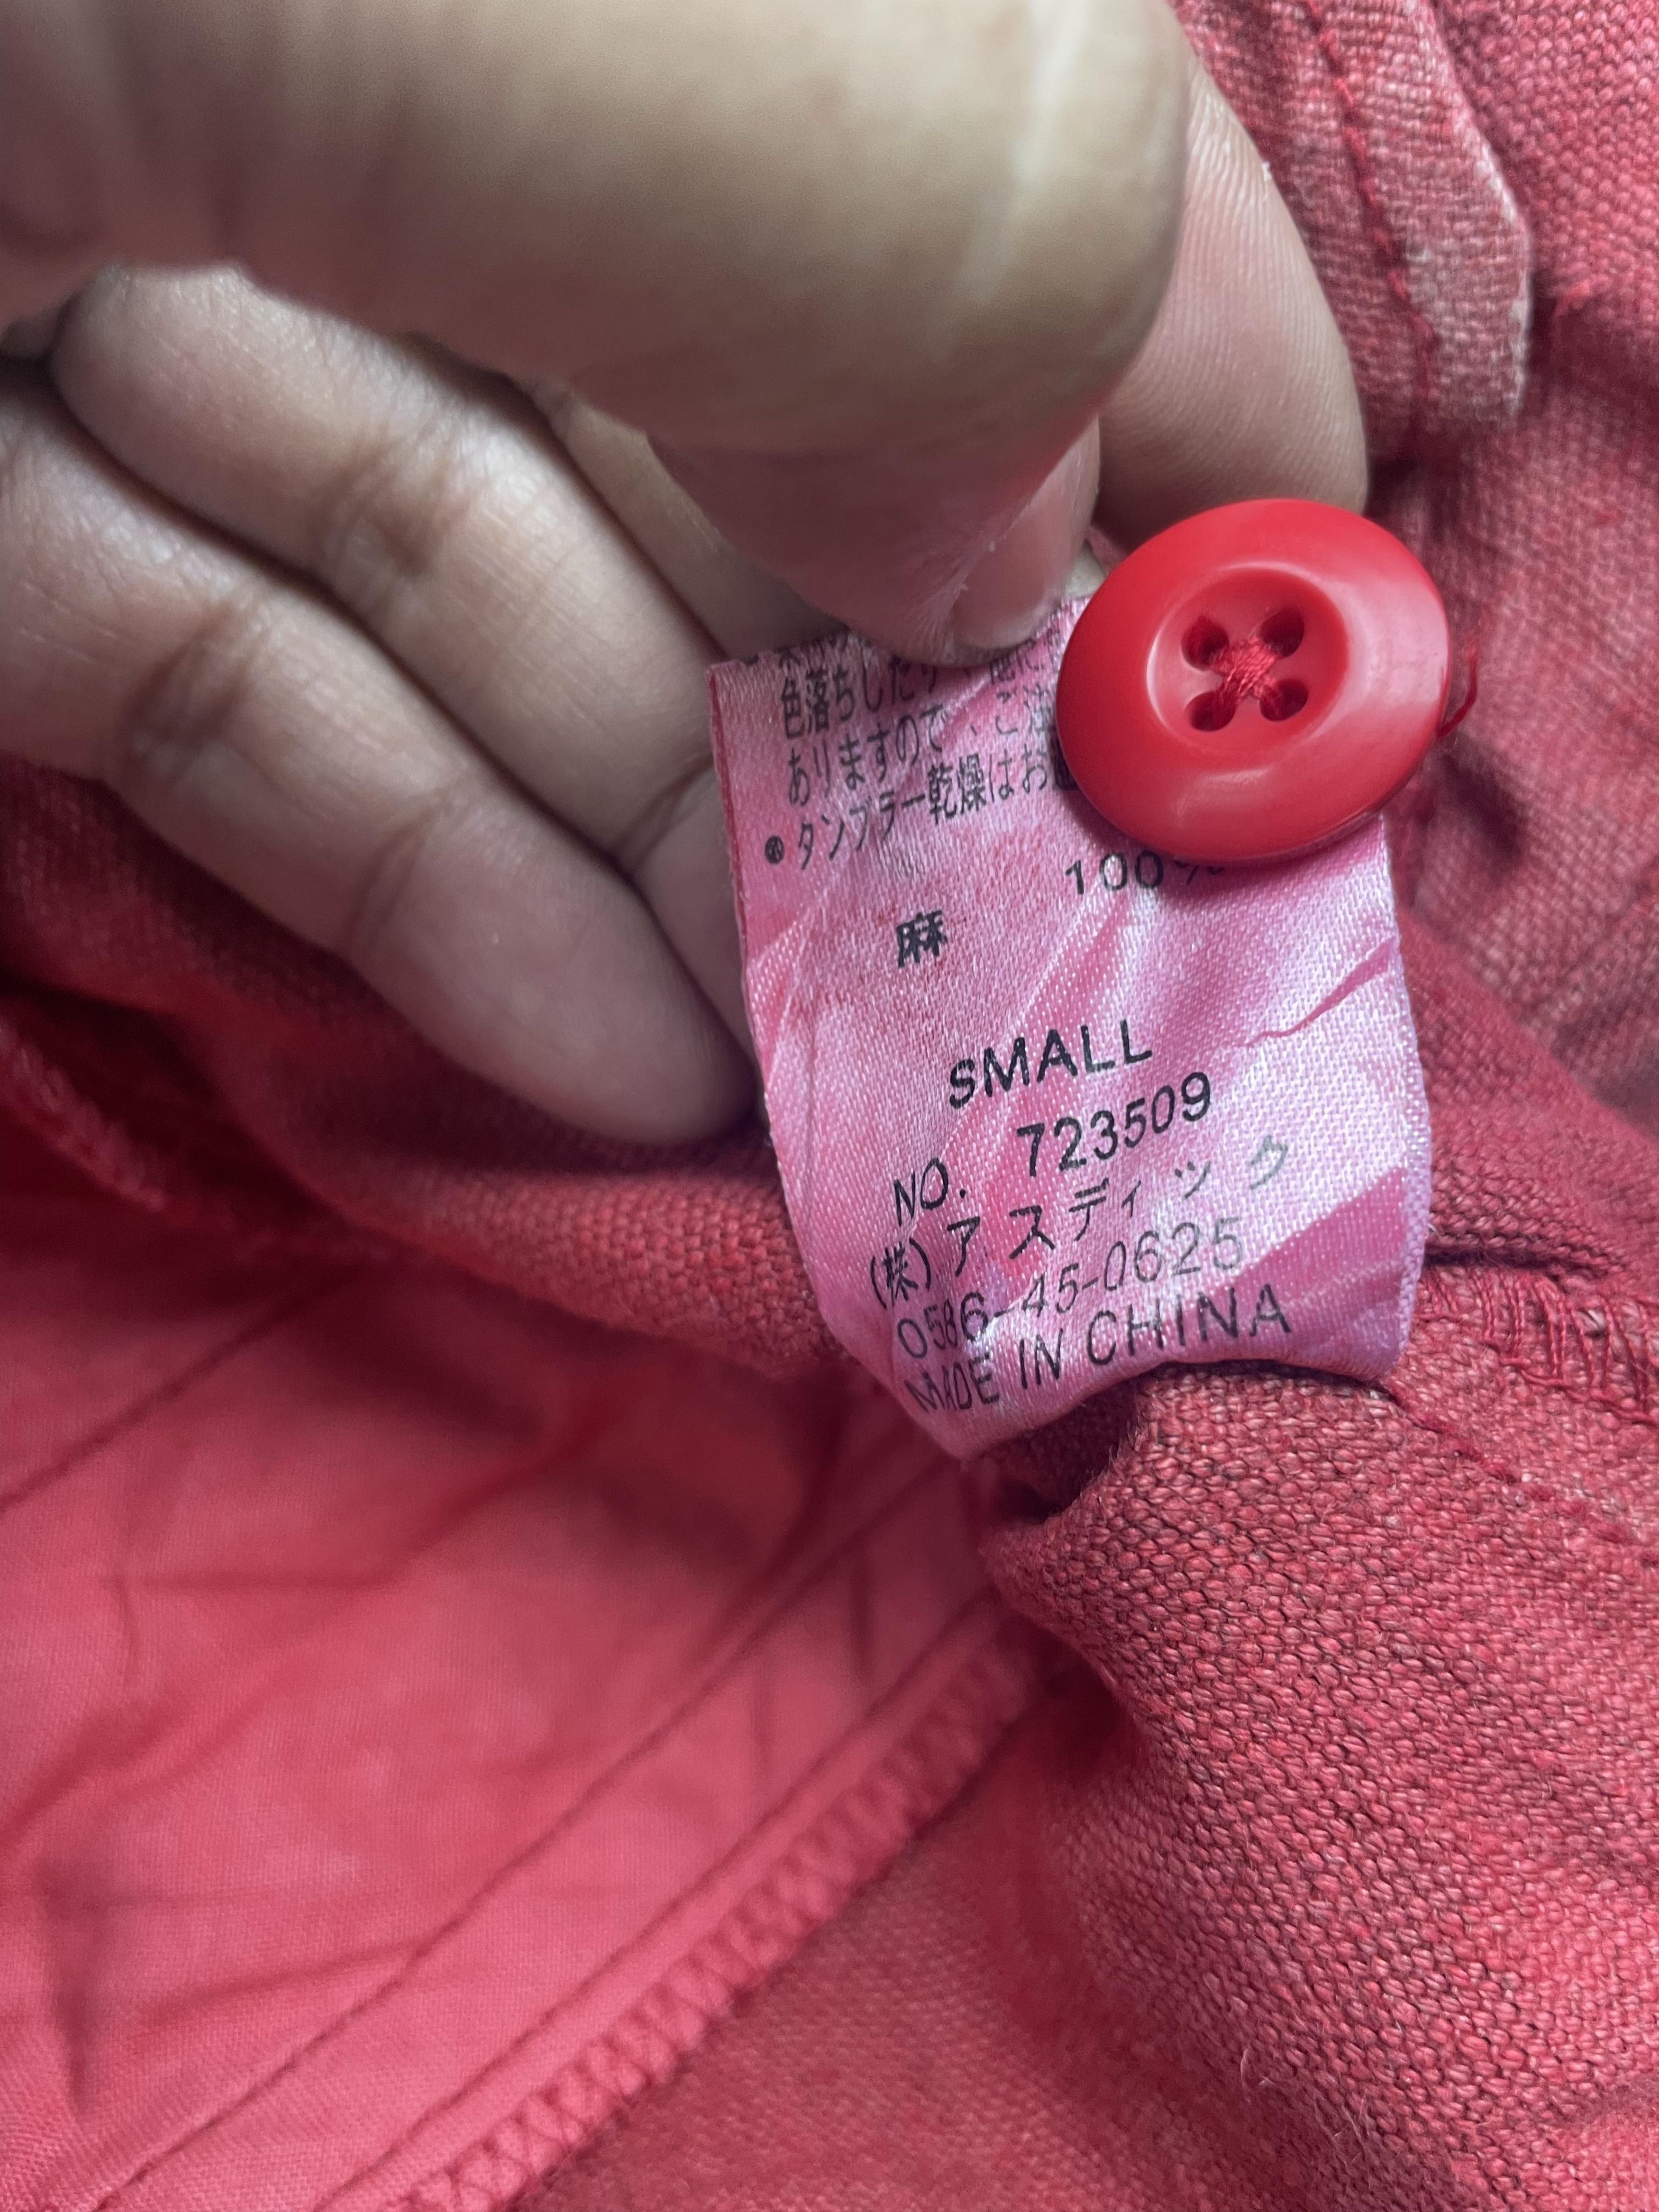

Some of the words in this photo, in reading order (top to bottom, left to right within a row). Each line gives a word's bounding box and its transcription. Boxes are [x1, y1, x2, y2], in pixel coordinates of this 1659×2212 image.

[896, 909, 948, 968] 麻
[949, 1019, 1153, 1110] SMALL
[893, 1157, 966, 1227] NO.
[1016, 1072, 1211, 1177] 723509
[1019, 1328, 1063, 1390] IN
[1087, 1284, 1292, 1366] CHINA
